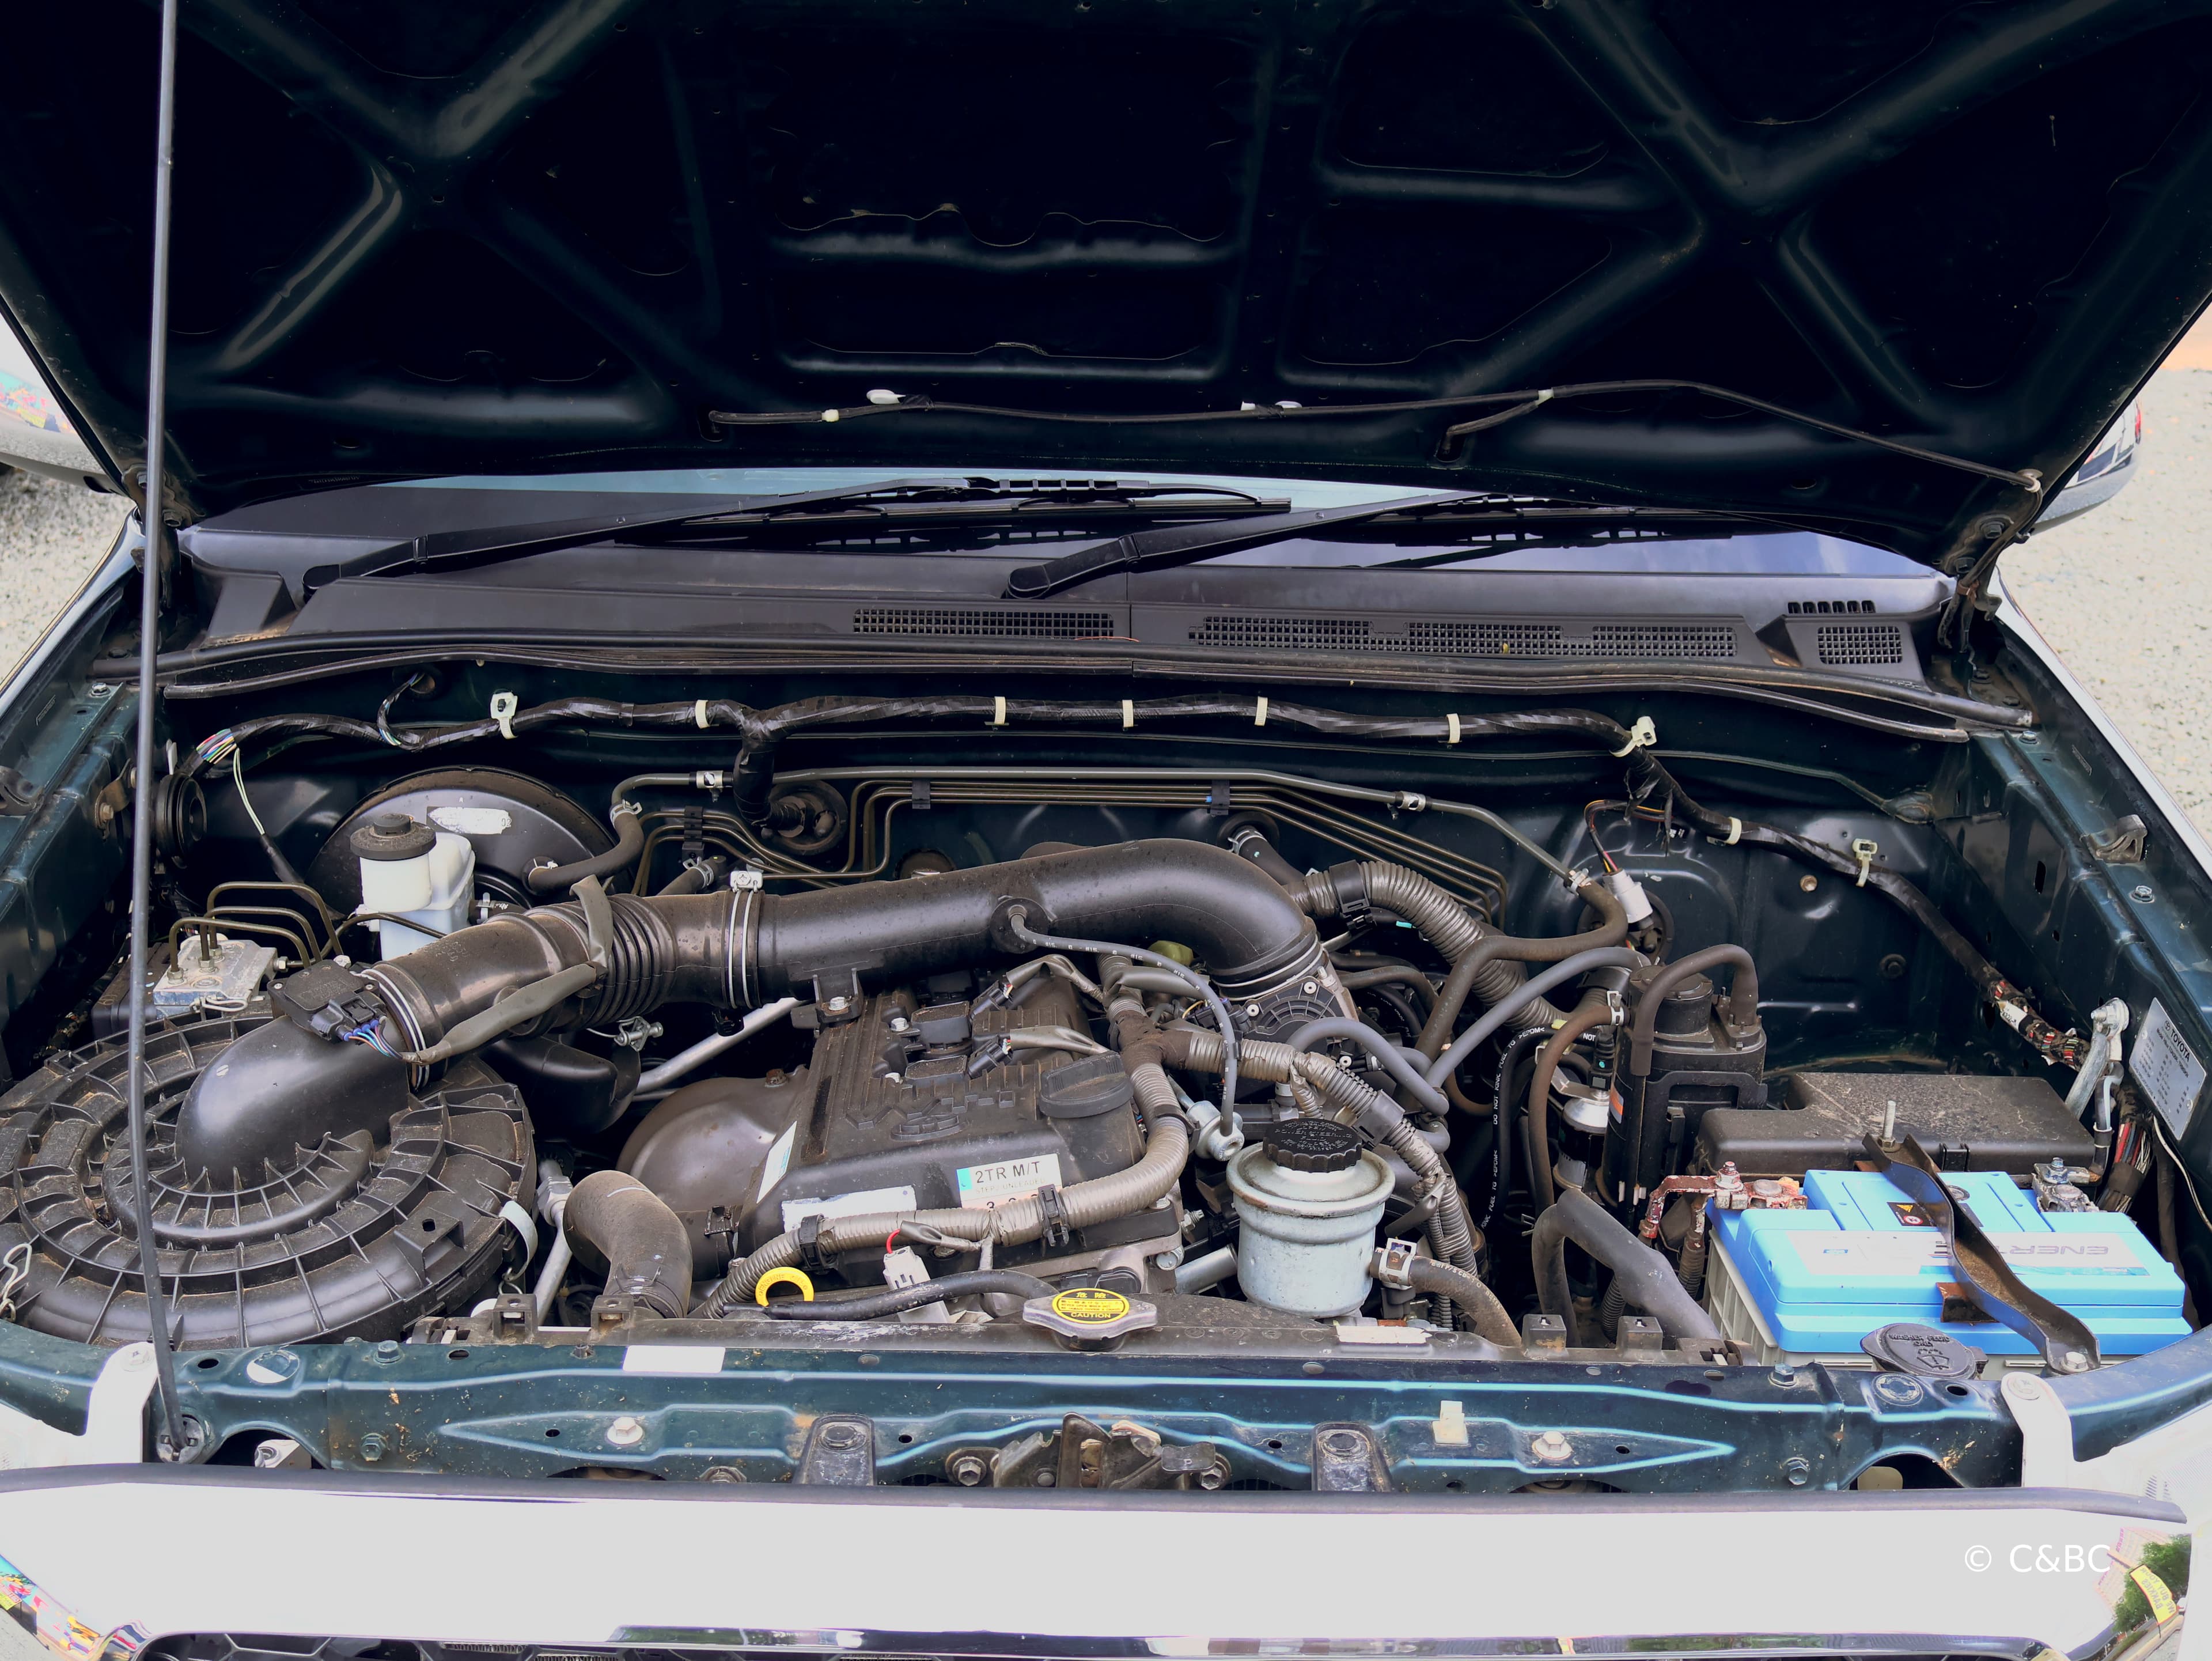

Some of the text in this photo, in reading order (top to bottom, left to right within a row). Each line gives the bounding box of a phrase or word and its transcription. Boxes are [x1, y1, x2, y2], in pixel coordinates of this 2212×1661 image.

[1583, 1033, 1596, 1042] NOT
[2170, 1028, 2191, 1062] TOYOTA
[1493, 1114, 1498, 1125] DO
[1498, 1052, 1508, 1069] FUEL
[975, 1161, 1040, 1183] 2TR M/T
